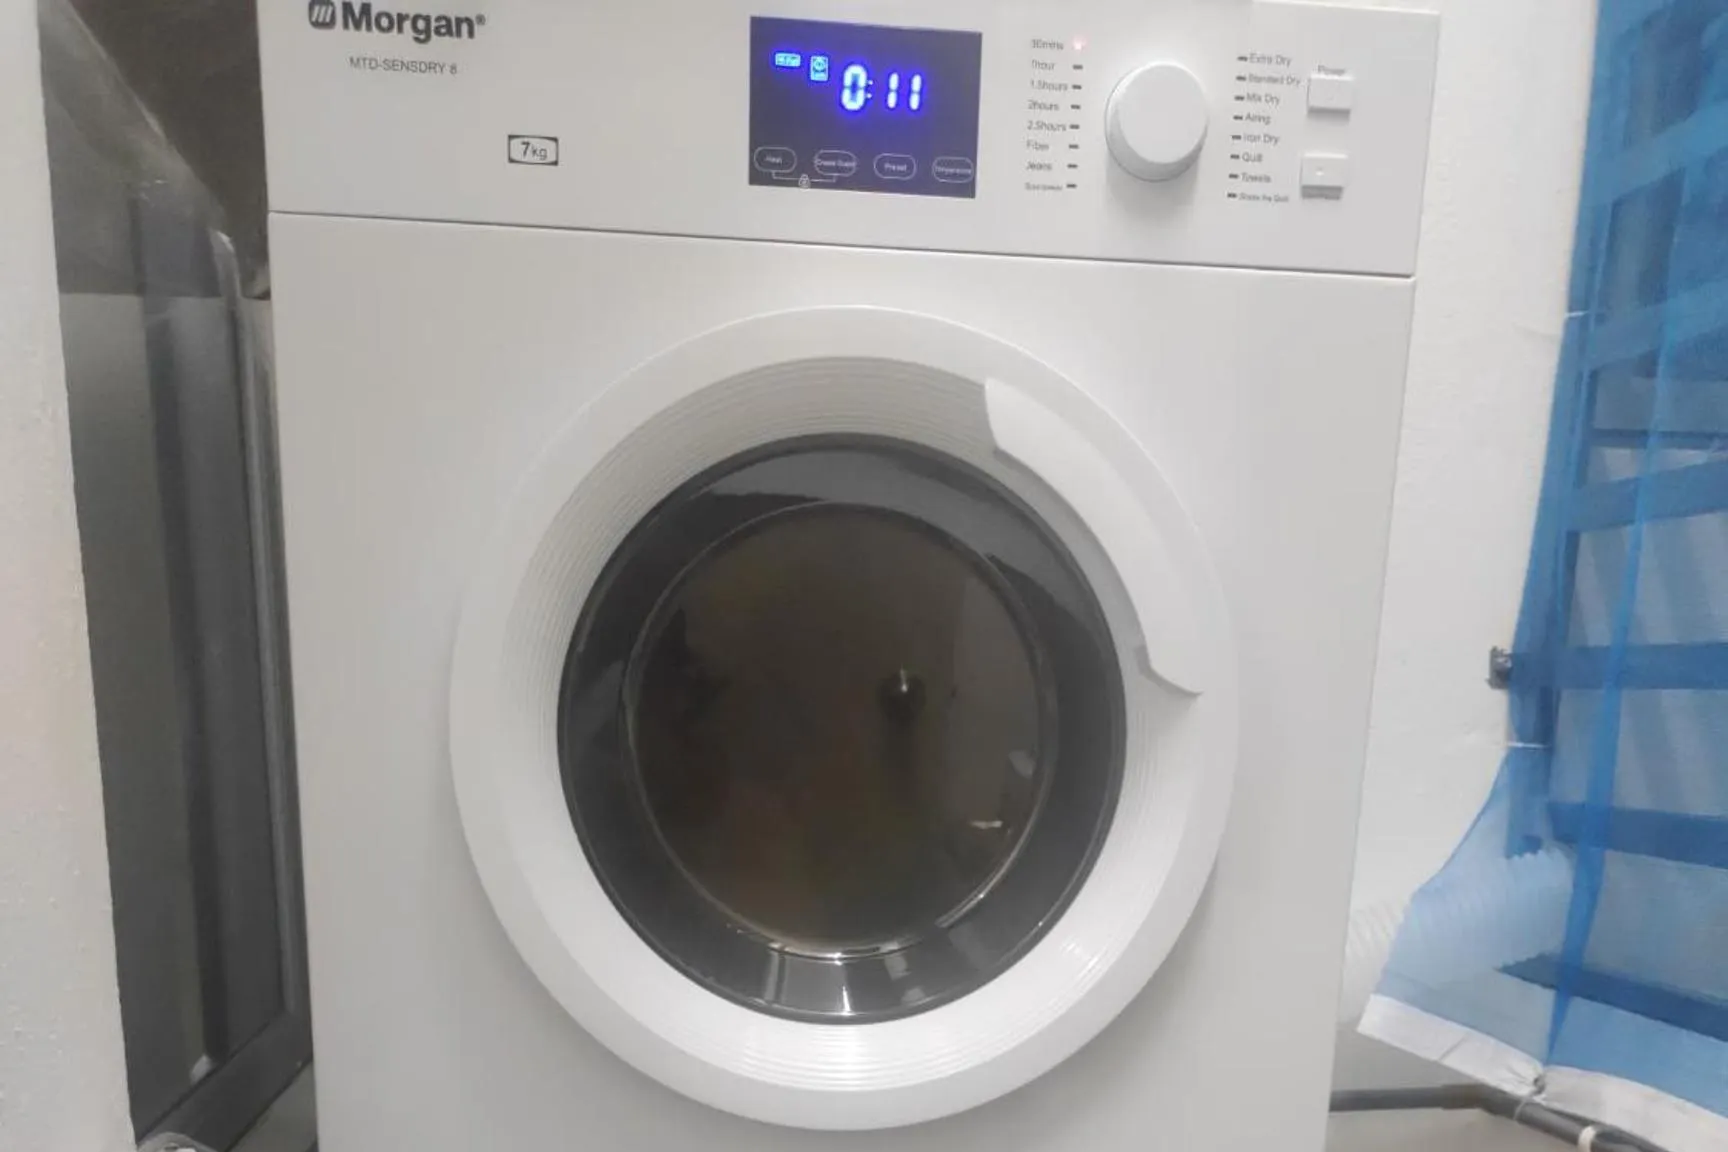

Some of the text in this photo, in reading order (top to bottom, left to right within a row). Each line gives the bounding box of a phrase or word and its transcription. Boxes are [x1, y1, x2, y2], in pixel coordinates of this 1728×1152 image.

[349, 56, 445, 74] MTD-SENSDRY
[1276, 54, 1291, 67] Dry
[841, 64, 921, 110] 0:11
[1265, 94, 1280, 106] Dry
[1263, 133, 1279, 146] Dry
[521, 141, 547, 160] 7kg
